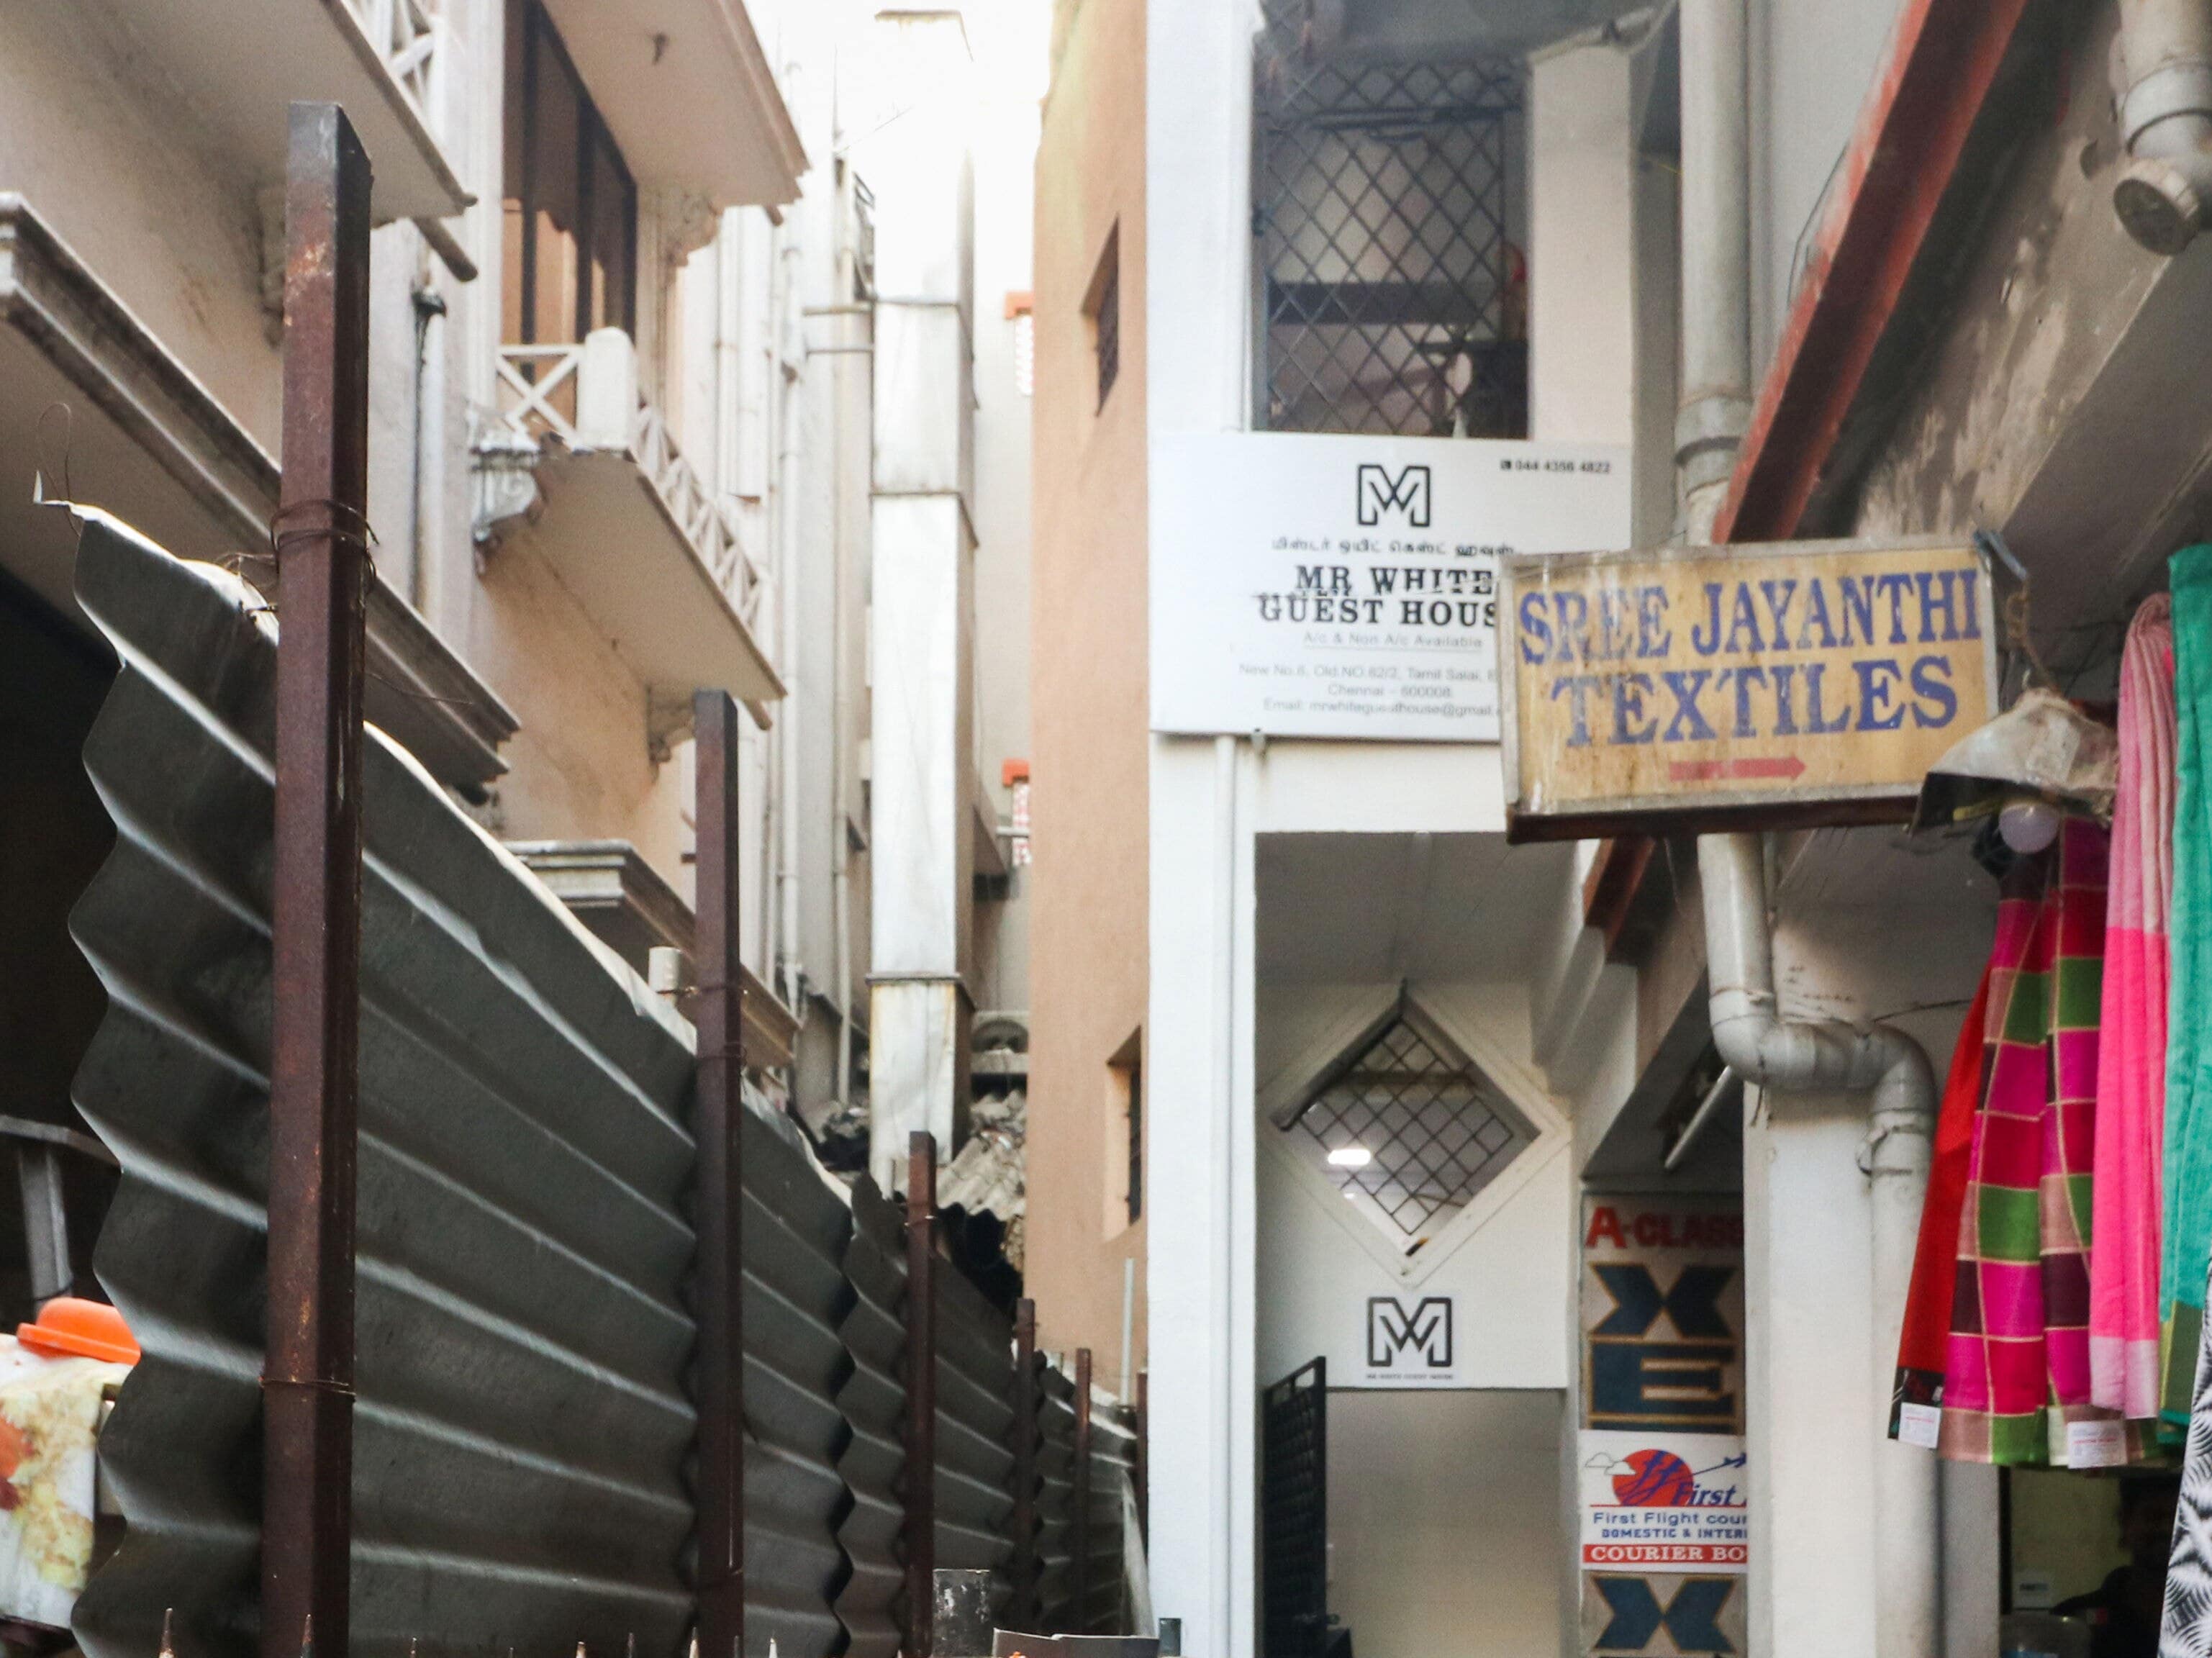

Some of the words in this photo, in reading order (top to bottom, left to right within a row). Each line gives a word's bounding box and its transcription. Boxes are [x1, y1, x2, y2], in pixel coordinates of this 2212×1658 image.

[1295, 566, 1351, 591] MR
[1369, 567, 1492, 595] WHITE
[1258, 596, 1384, 625] GUEST
[1518, 586, 1671, 665] SREE
[1692, 568, 1980, 656] JAYANTHI
[1413, 635, 1482, 648] Available
[1328, 683, 1384, 697] Chennai
[1551, 656, 1958, 748] TEXTILES
[1670, 1480, 1736, 1505] First
[1593, 1512, 1636, 1524] First
[1644, 1513, 1700, 1526] Flight
[1602, 1528, 1677, 1539] DOMESTIC
[1682, 1529, 1691, 1539] &
[1590, 1546, 1703, 1561] COURIER
